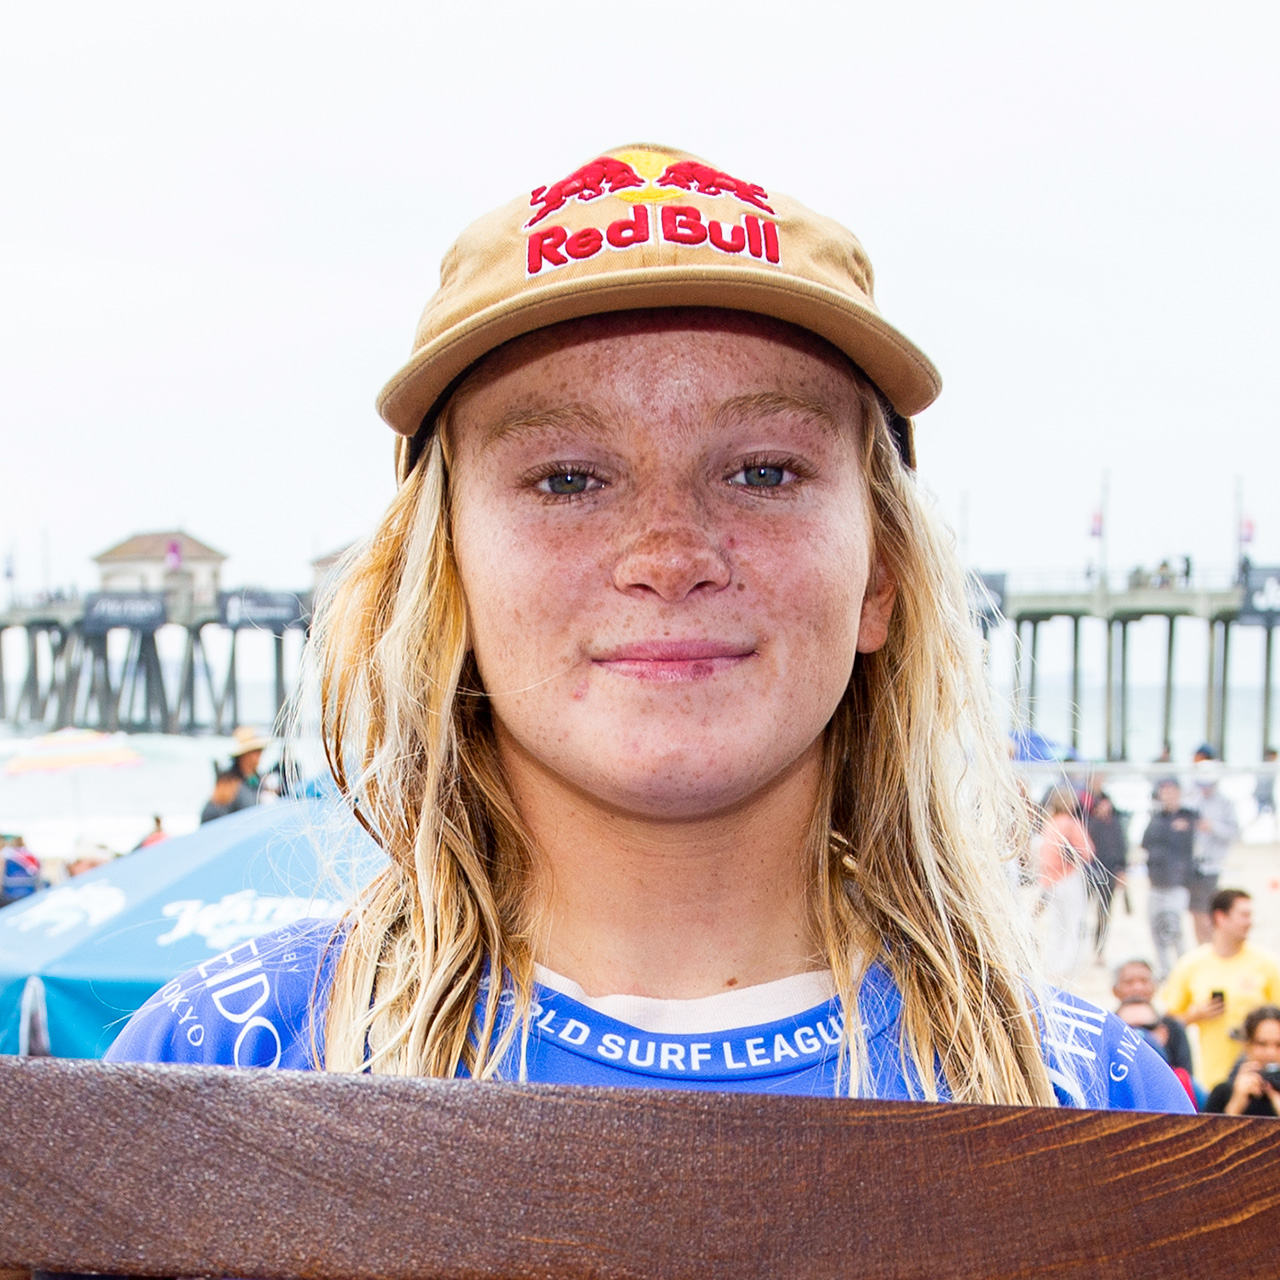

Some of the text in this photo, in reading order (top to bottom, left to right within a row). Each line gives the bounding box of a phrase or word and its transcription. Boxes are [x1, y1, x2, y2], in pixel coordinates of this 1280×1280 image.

[526, 204, 780, 275] Red Bull
[162, 977, 206, 1047] OKYO
[596, 1030, 713, 1072] SURF
[722, 1009, 872, 1069] LEAGU
